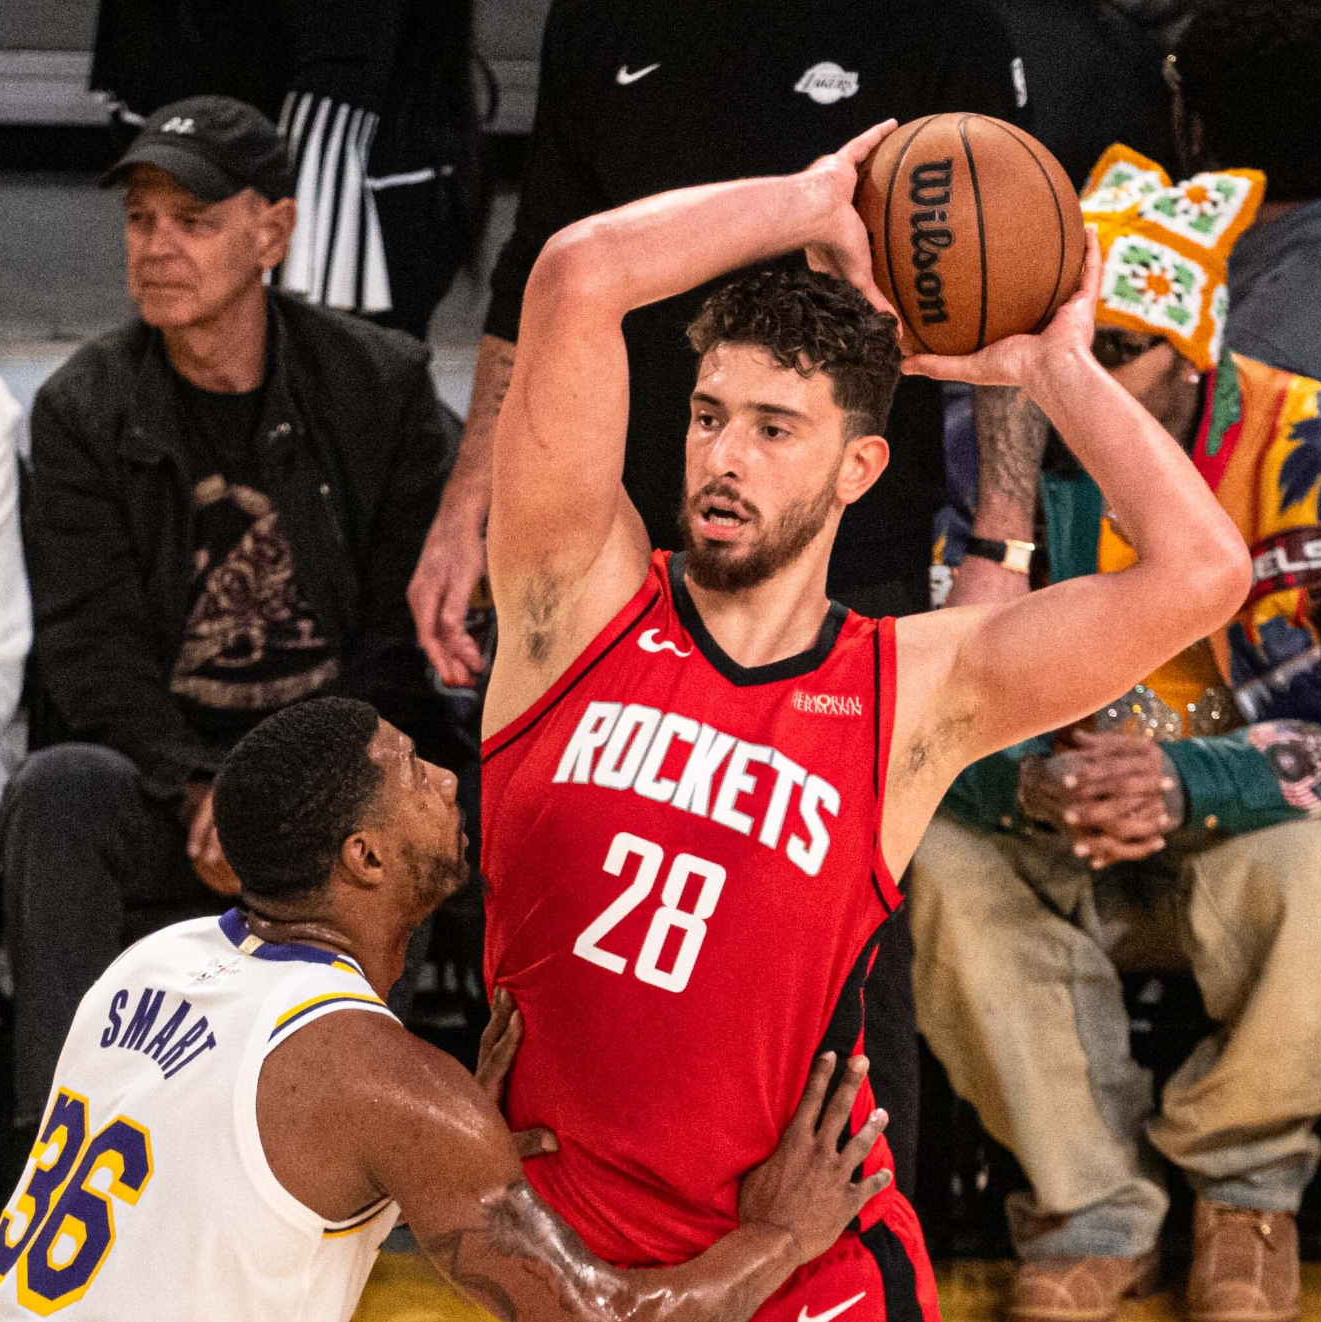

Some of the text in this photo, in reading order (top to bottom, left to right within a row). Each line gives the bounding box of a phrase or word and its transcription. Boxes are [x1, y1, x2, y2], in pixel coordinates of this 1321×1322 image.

[908, 156, 955, 327] Wilson
[551, 700, 841, 878] ROCKETS
[572, 831, 728, 993] 28
[100, 987, 217, 1080] SMART
